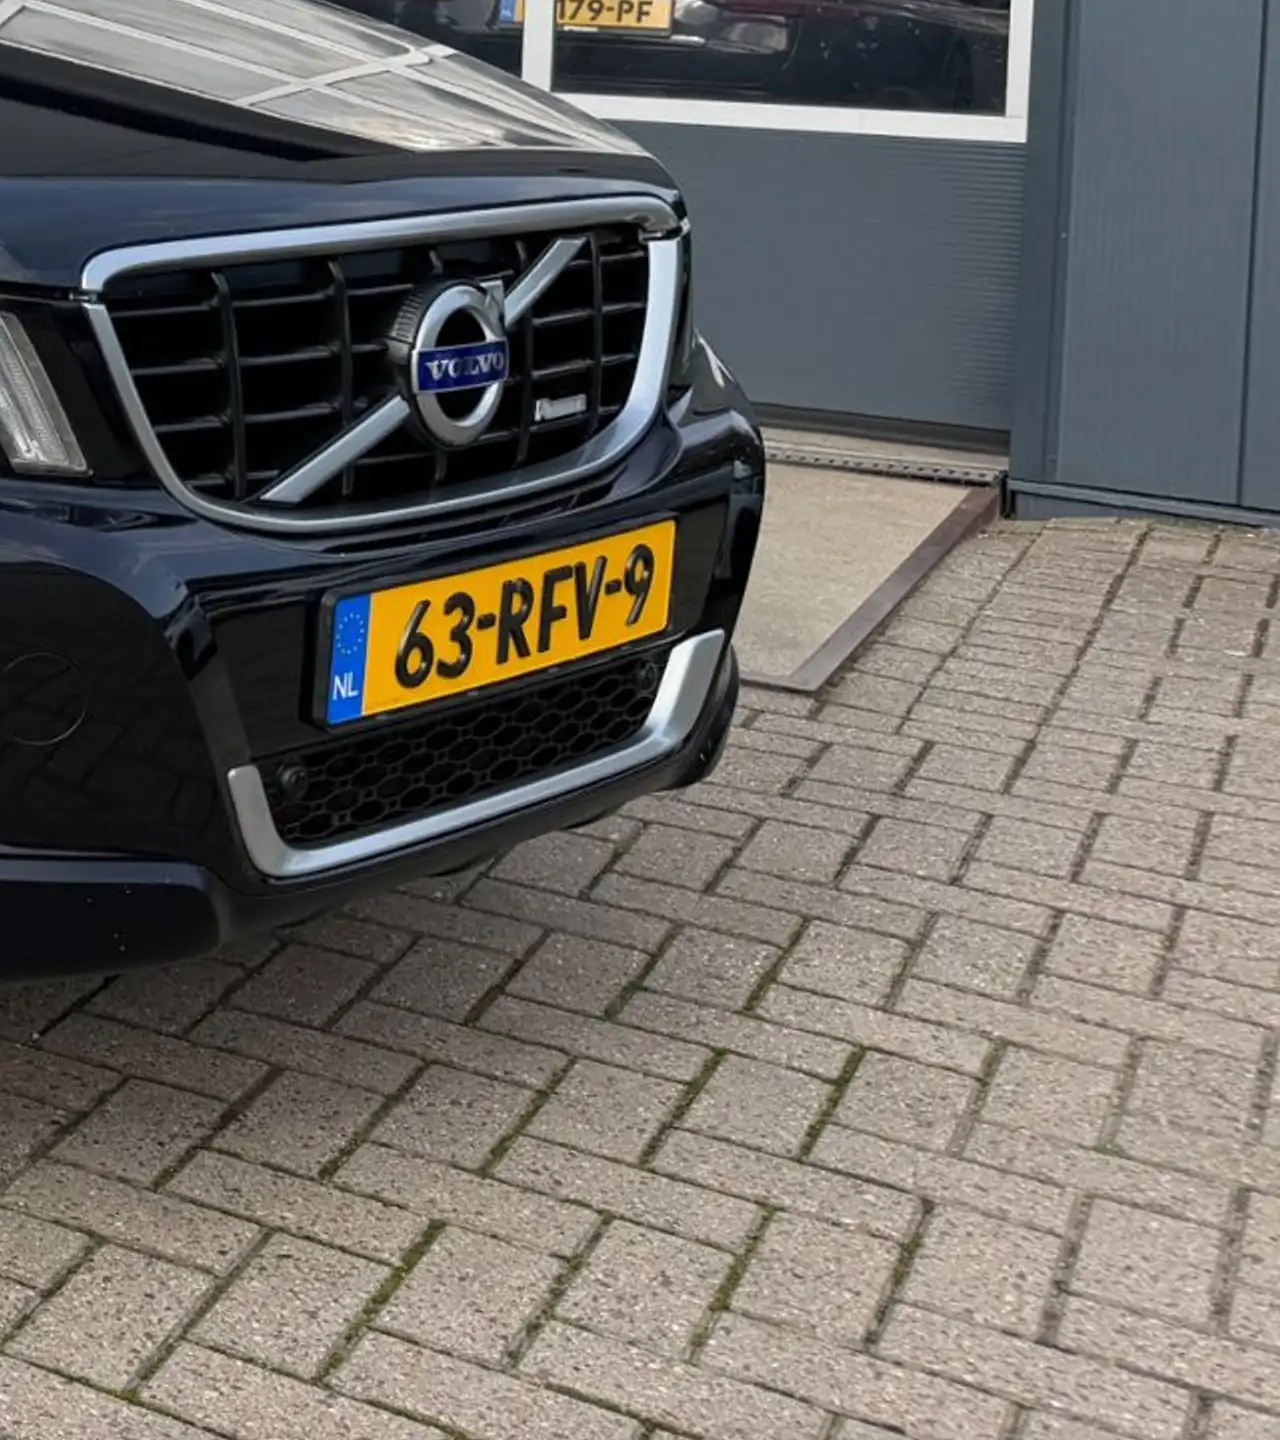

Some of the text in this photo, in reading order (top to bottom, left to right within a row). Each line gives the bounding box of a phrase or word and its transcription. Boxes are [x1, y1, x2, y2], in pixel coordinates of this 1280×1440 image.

[425, 351, 505, 381] VOLVO
[394, 543, 655, 689] 63-RFV-9
[332, 671, 359, 702] NL
